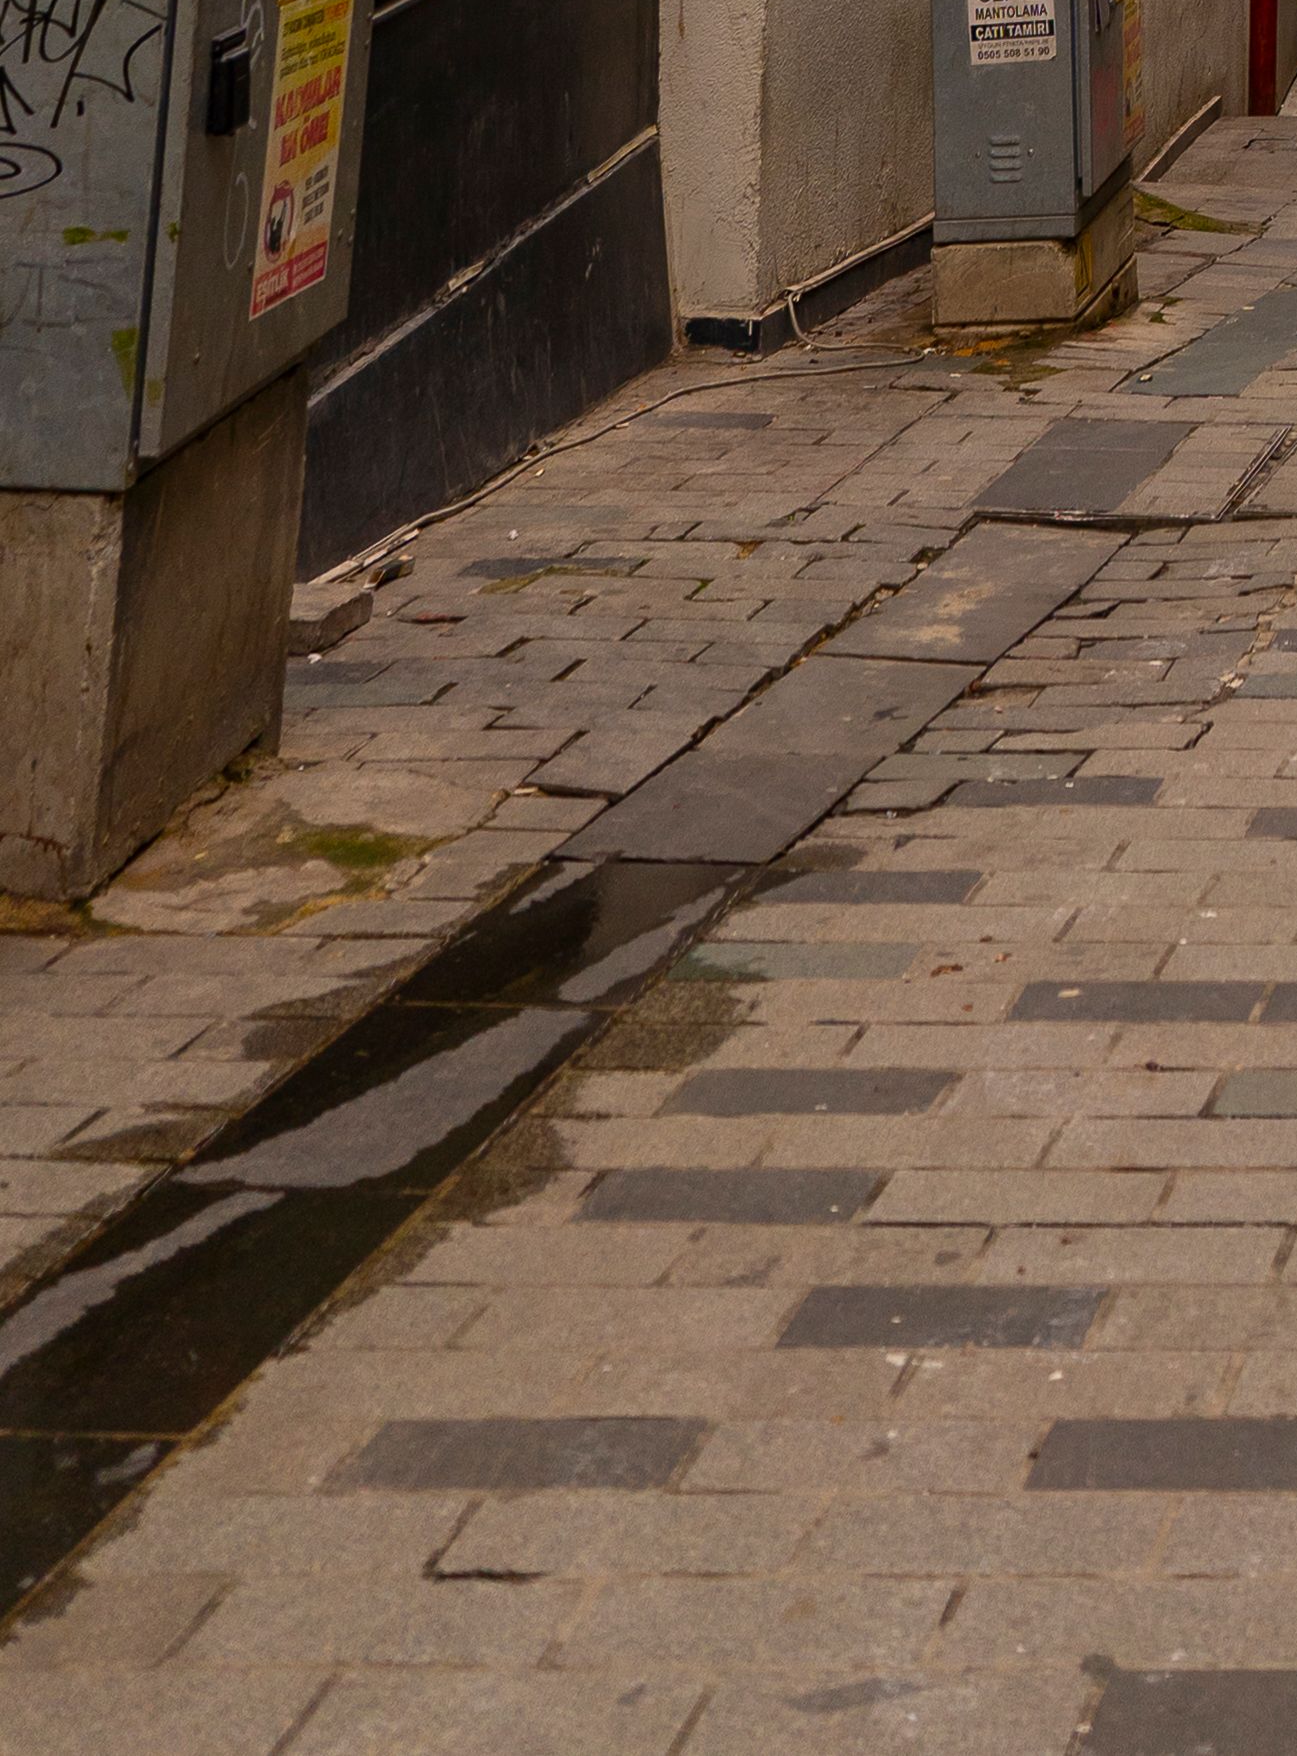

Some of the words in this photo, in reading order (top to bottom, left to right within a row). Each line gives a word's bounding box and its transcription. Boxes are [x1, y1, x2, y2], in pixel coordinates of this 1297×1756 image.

[976, 4, 1048, 21] MANTOLAMA
[976, 24, 1005, 40] ÇATI
[978, 49, 1001, 60] 0505
[1003, 48, 1021, 58] 508
[1024, 48, 1035, 57] 51
[1038, 46, 1050, 56] 90
